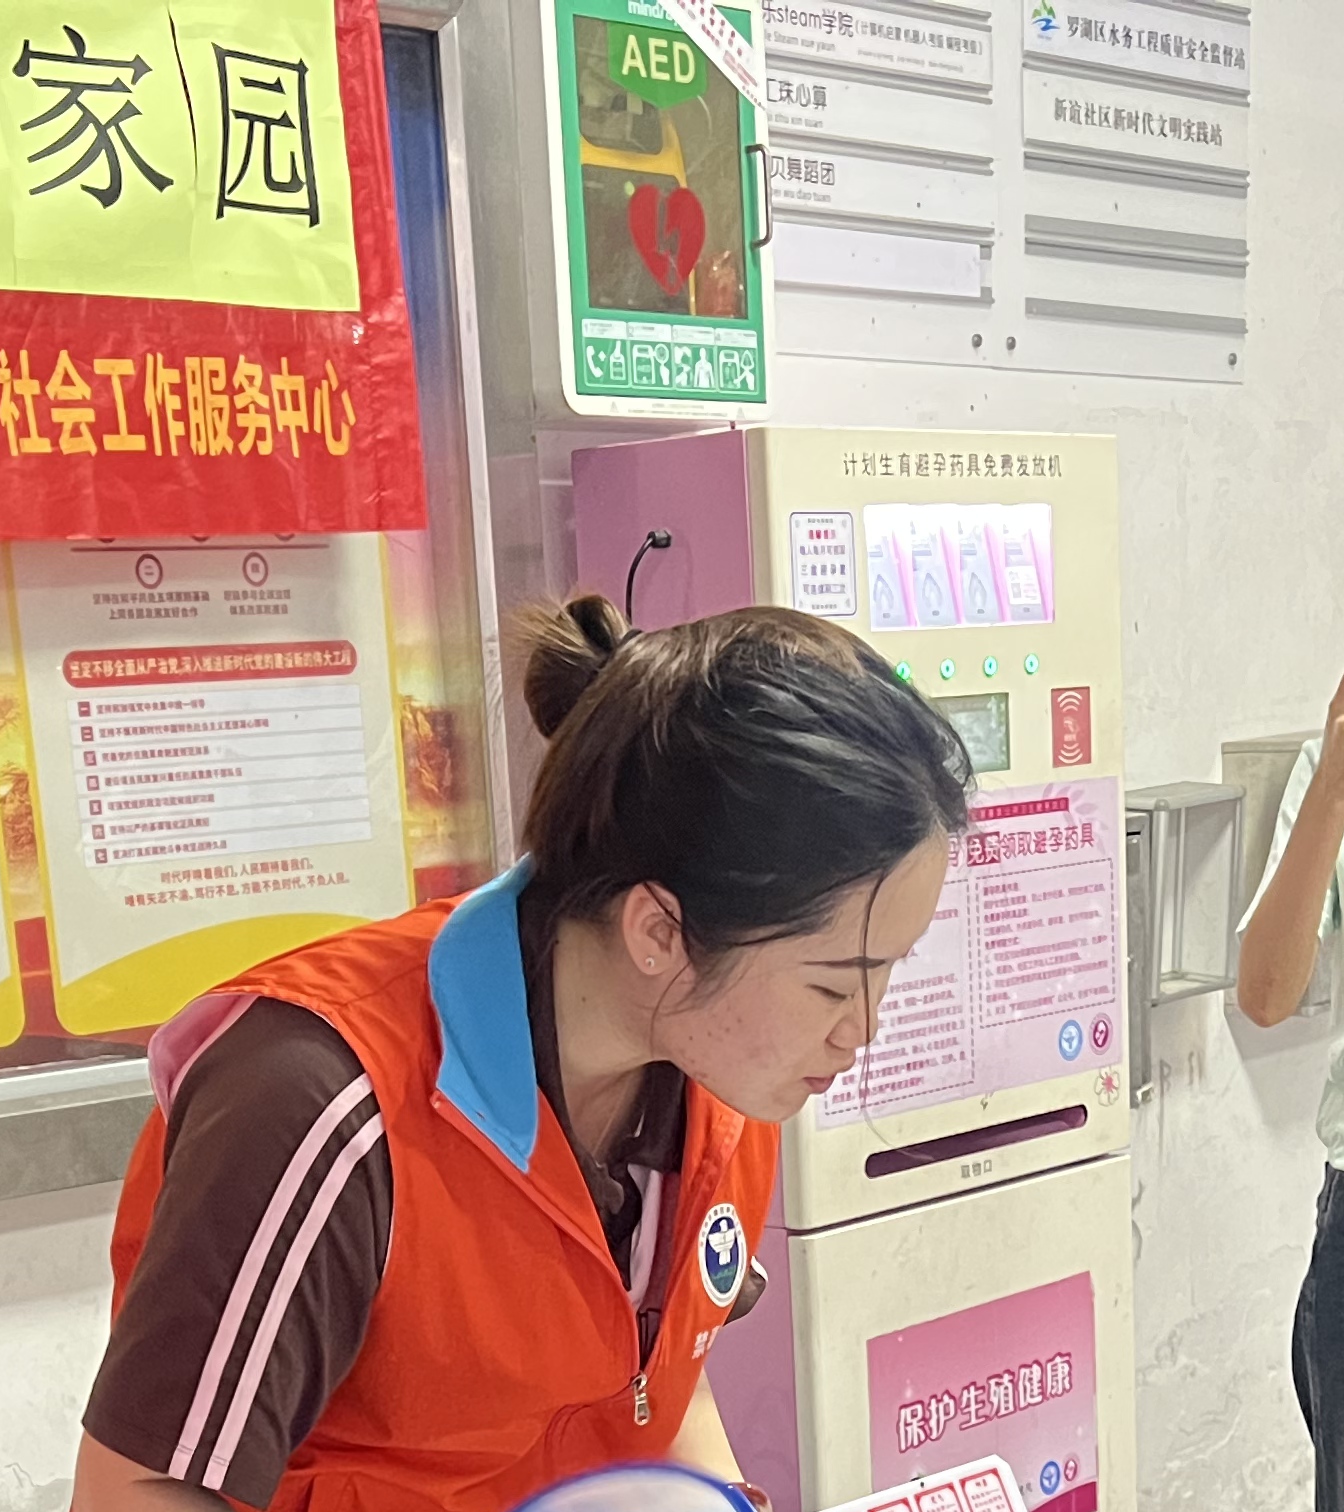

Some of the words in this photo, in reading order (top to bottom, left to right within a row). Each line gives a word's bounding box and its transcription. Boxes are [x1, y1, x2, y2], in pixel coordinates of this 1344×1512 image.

[621, 35, 696, 84] AED
[1054, 97, 1223, 147] 新谊社区新时代文明实践站
[843, 452, 1063, 478] 计划生育避孕药具免费发放机
[896, 1350, 1073, 1452] 保护生殖健康
